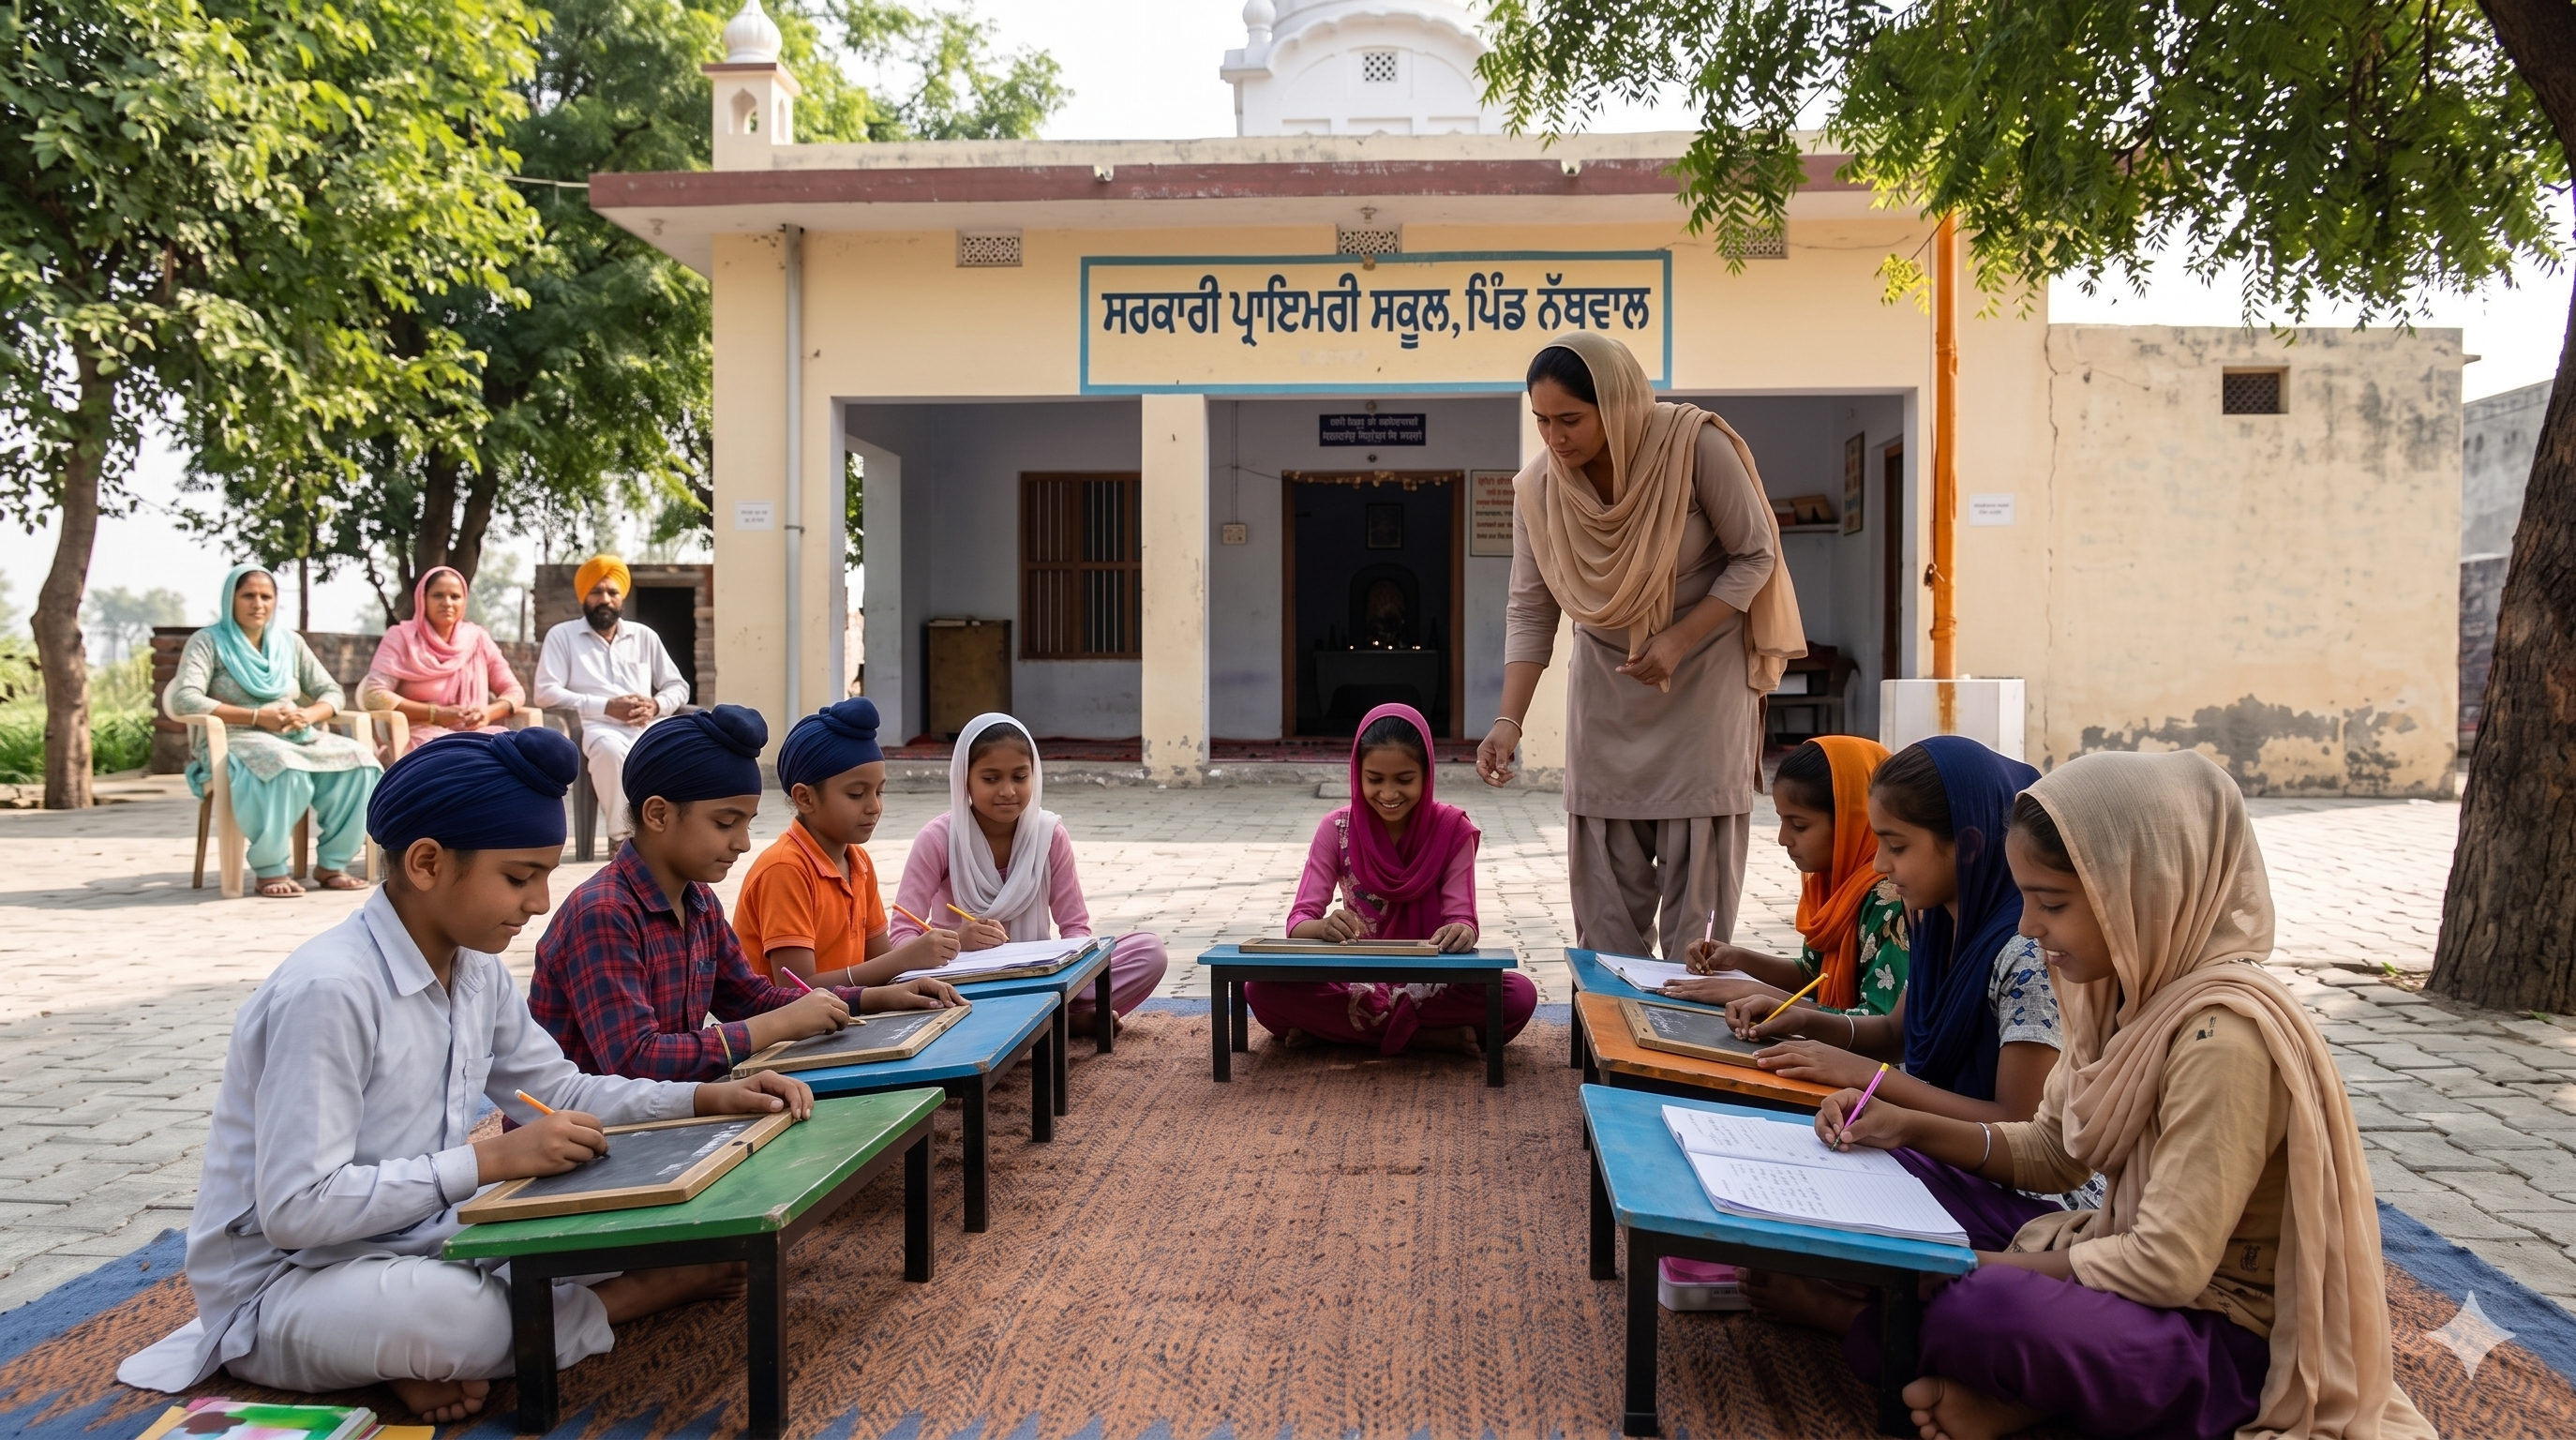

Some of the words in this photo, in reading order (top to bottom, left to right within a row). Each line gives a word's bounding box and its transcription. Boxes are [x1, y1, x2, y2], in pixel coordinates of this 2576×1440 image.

[1101, 275, 1221, 334] ਸਰਕਾਰੀ
[1230, 273, 1361, 347] ਪ੍ਰਾਇਮਰੀ
[1465, 272, 1528, 331] ਪਿੰਡ
